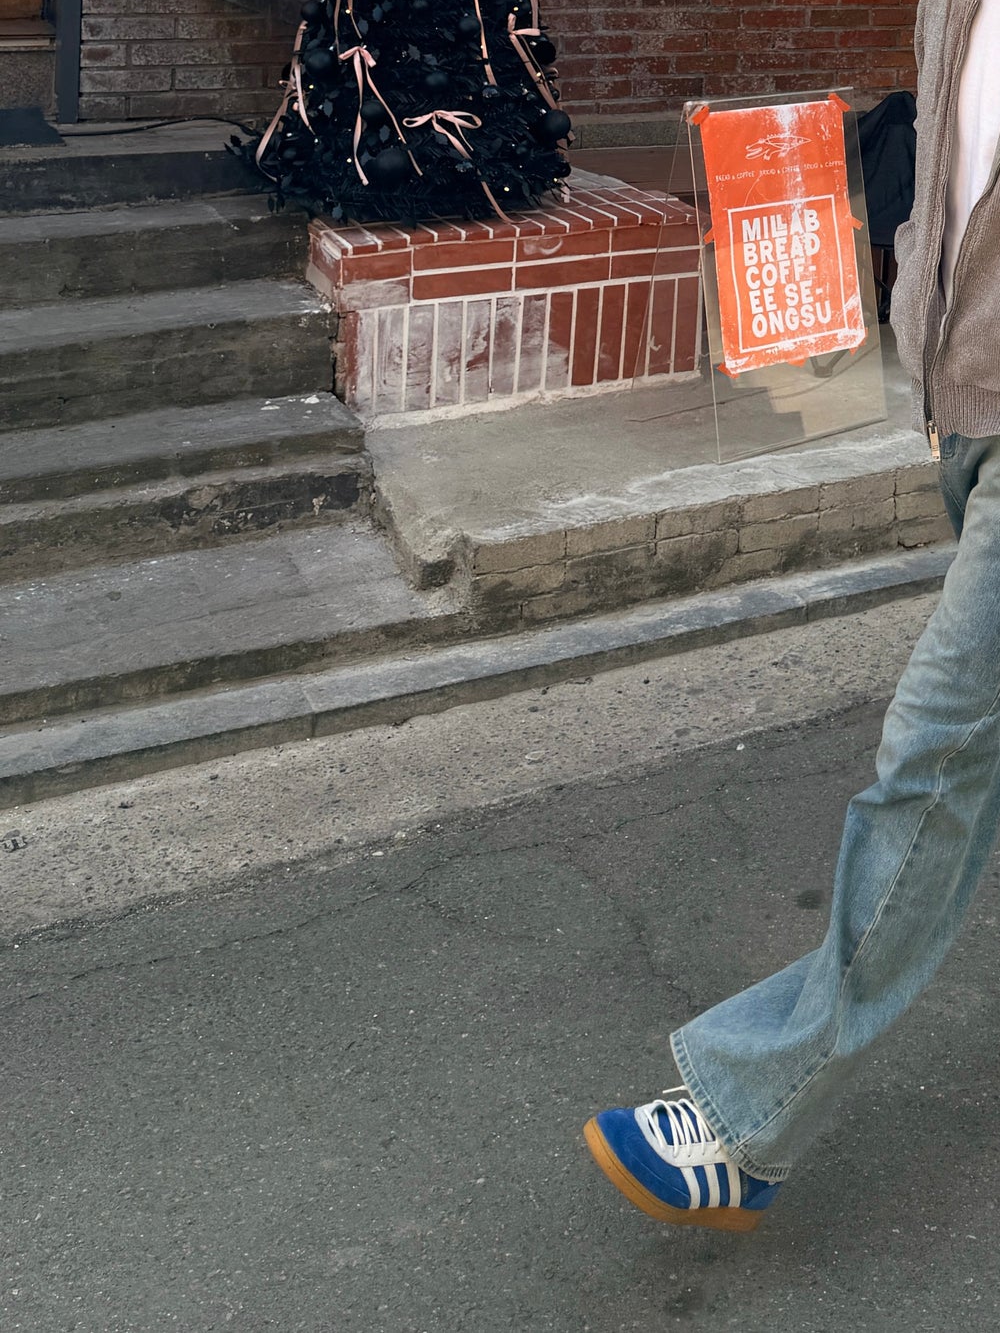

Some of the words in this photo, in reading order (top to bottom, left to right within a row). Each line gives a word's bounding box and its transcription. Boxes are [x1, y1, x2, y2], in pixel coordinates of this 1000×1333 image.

[741, 208, 820, 243] MILLAB
[743, 232, 821, 266] BREAD
[745, 258, 816, 290] COFF-
[748, 287, 778, 315] EE
[784, 279, 823, 307] SE-
[751, 300, 832, 339] ONGSU
